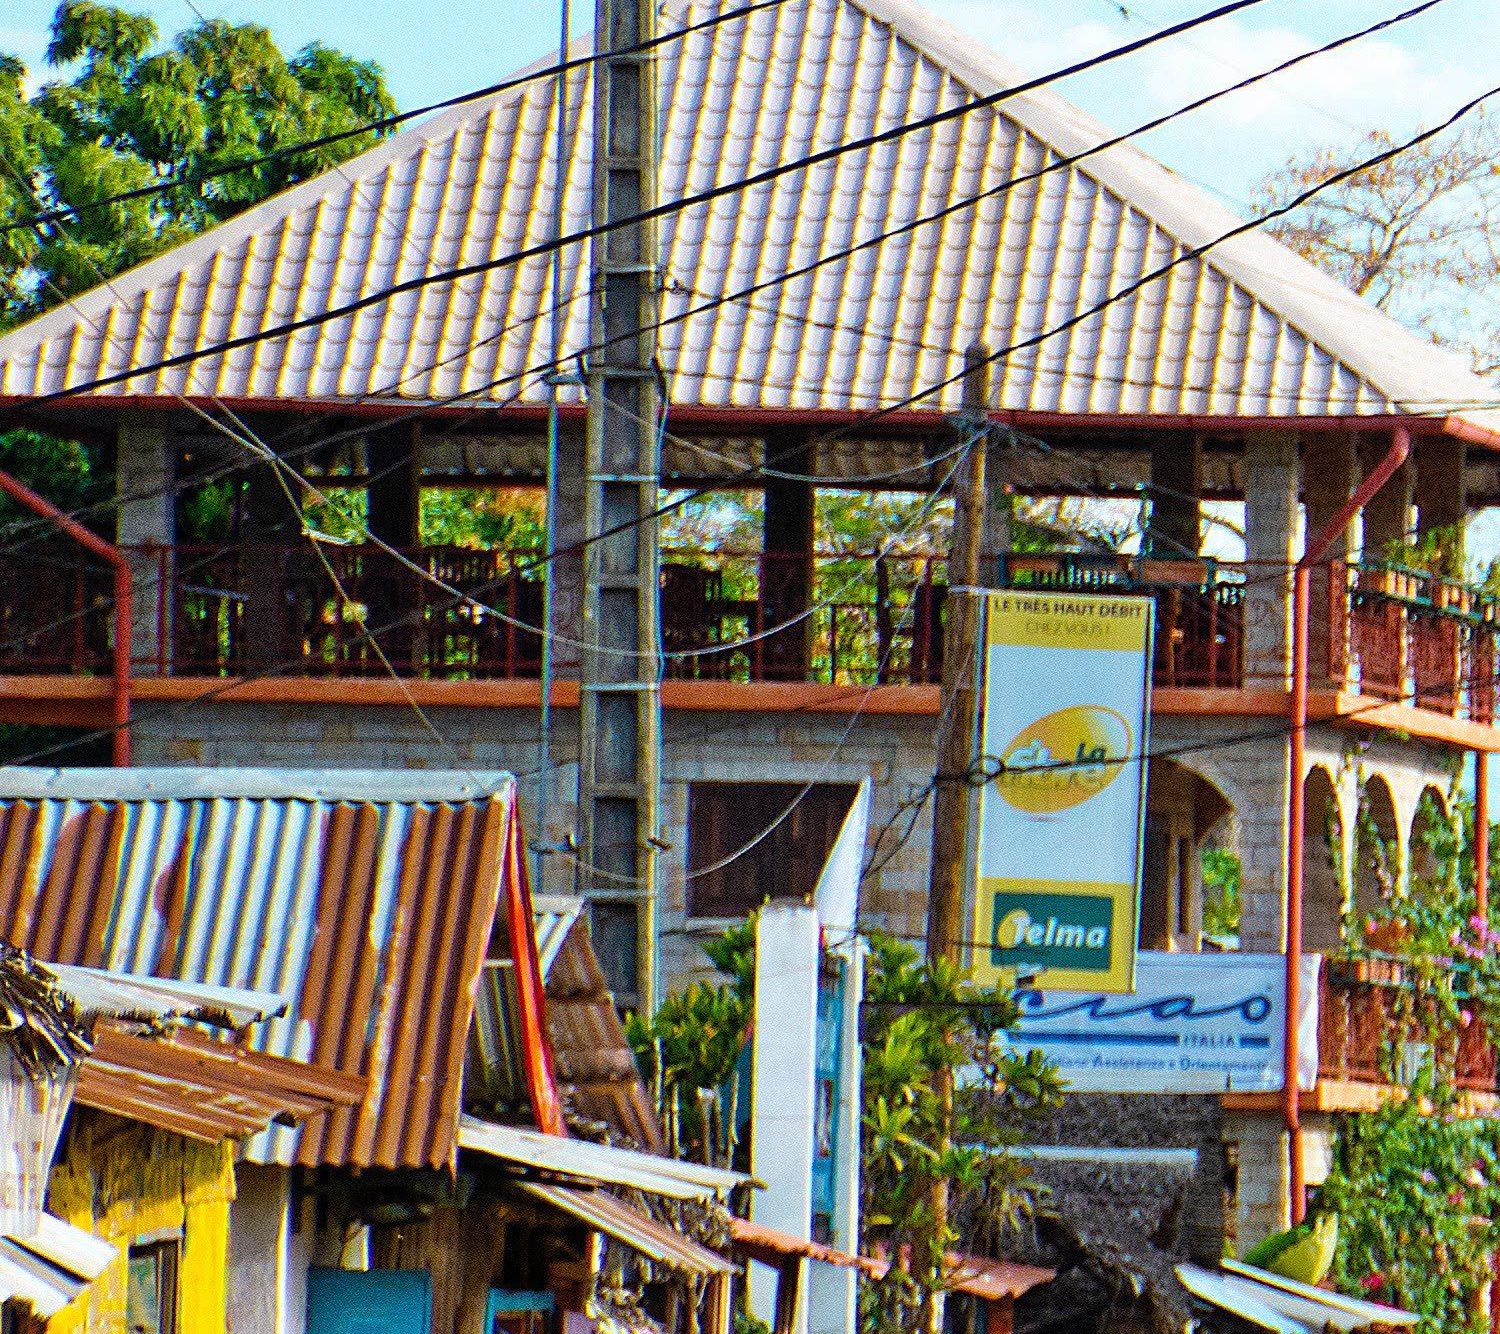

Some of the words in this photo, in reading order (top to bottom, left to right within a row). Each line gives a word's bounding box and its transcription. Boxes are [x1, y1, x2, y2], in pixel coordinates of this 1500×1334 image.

[1053, 603, 1094, 616] HAUT
[997, 908, 1109, 948] Telma
[1182, 1034, 1236, 1048] ITALIA
